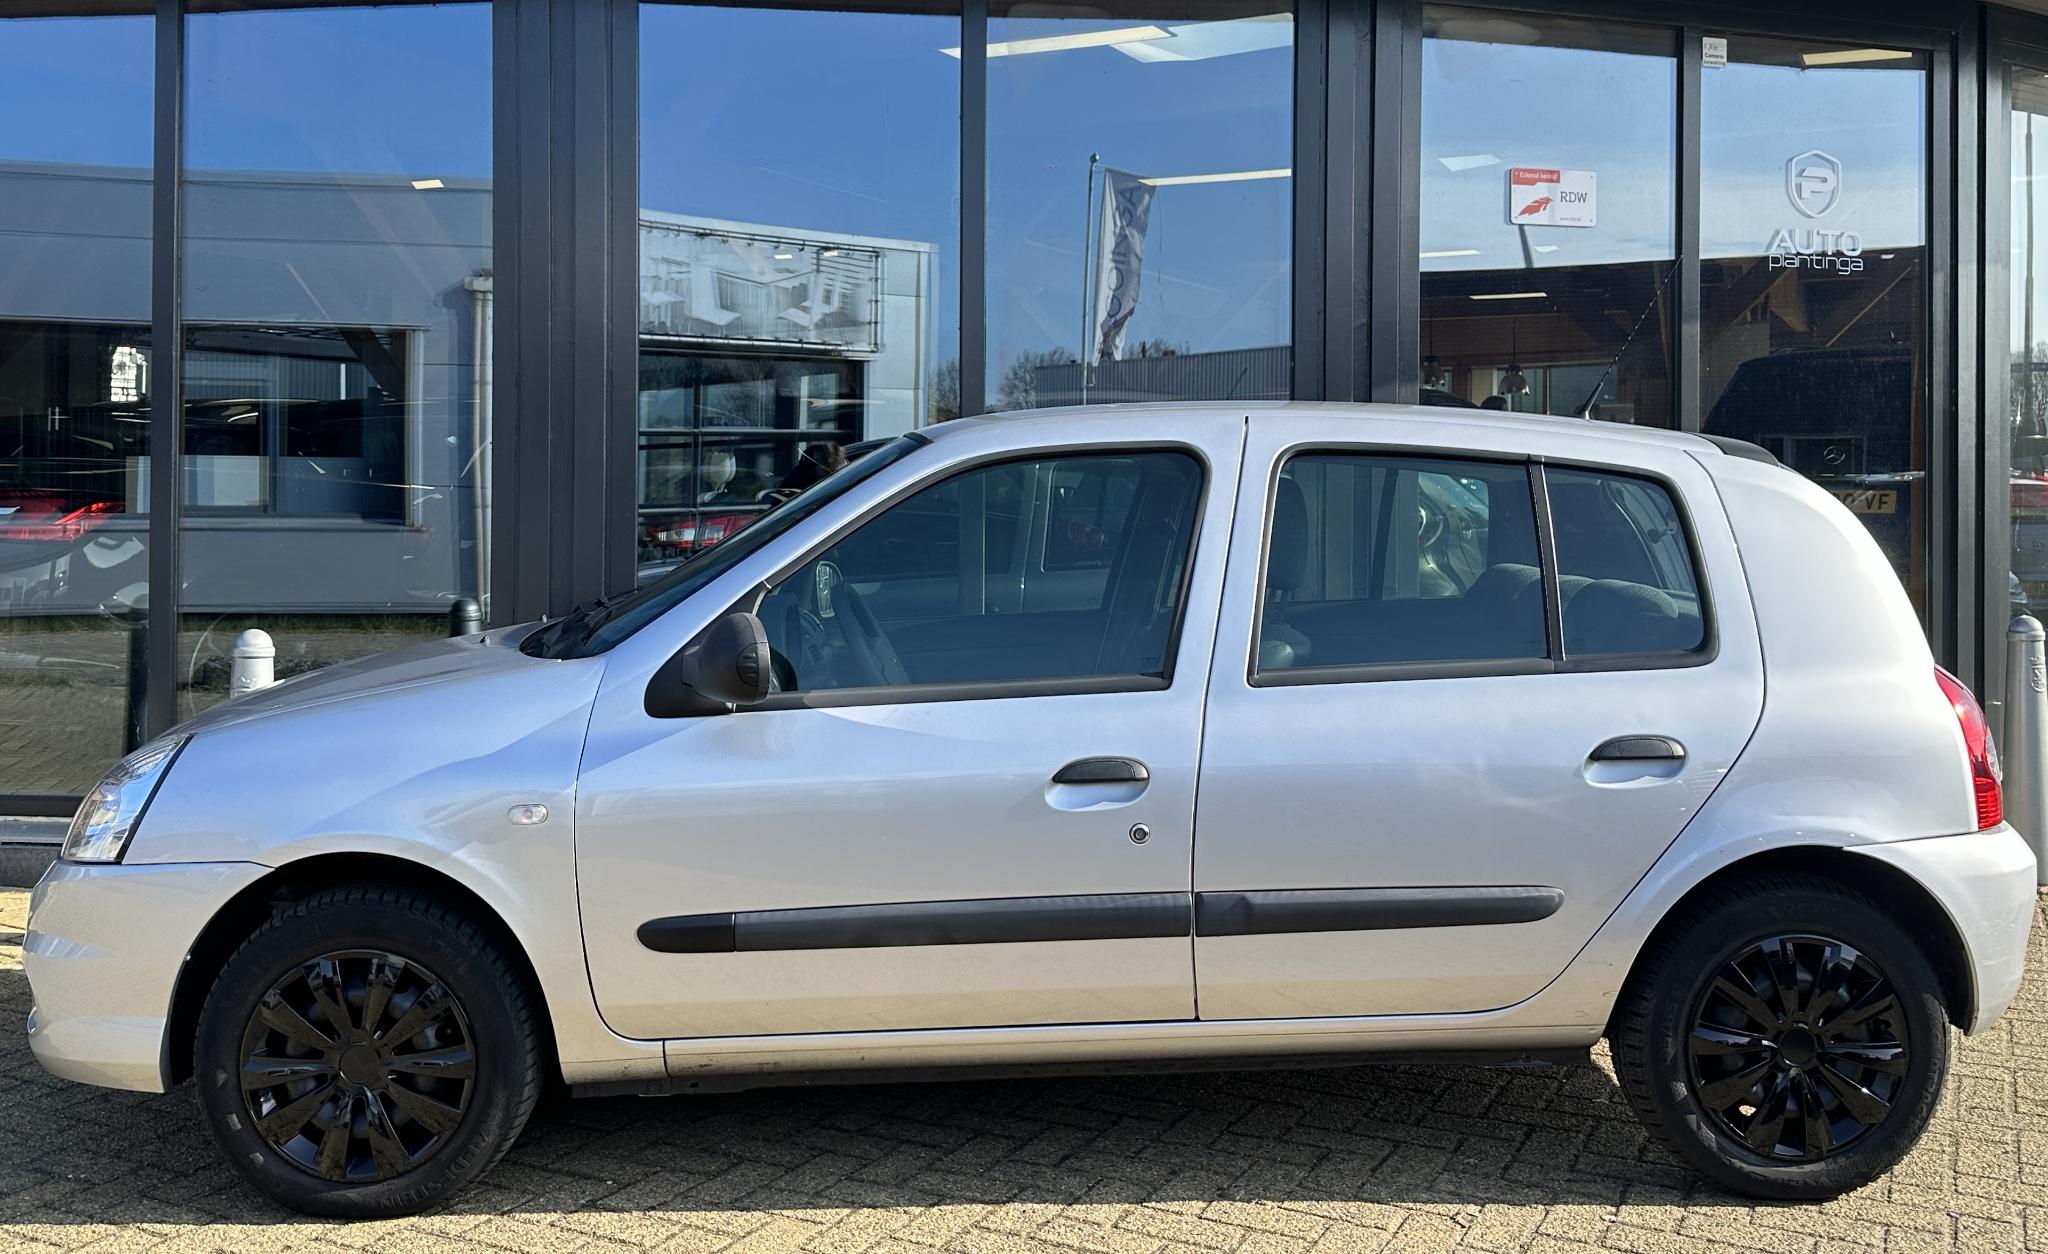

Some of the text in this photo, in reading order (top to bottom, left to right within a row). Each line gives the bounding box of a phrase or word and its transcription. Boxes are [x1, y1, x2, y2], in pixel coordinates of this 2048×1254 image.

[1559, 191, 1588, 203] RDW
[1769, 227, 1864, 257] AUTO
[1769, 251, 1864, 275] plantinga
